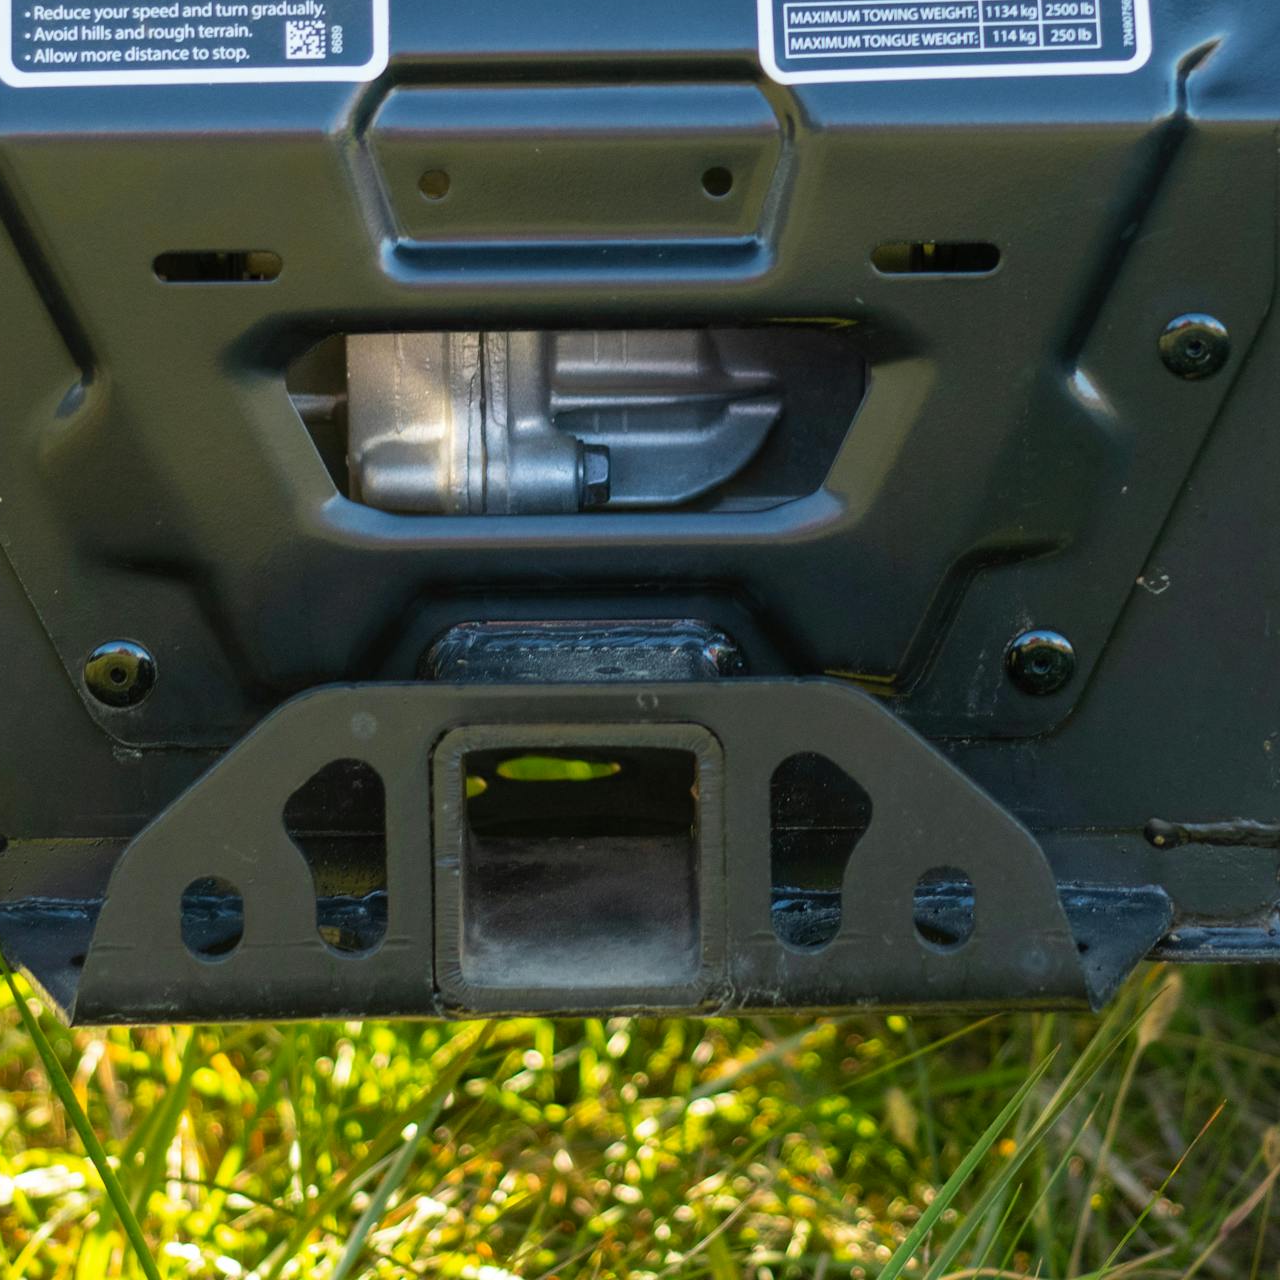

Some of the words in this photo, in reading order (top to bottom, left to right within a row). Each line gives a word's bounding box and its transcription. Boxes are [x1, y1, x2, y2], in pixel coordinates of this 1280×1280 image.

[33, 4, 91, 21] Reduce
[93, 7, 130, 23] your
[132, 2, 179, 22] speed
[182, 2, 212, 18] and
[215, 3, 248, 17] turn
[251, 0, 326, 20] gradually.
[790, 9, 861, 24] MAXIMUM
[861, 7, 919, 22] TOWING
[920, 6, 977, 20] WEIGHT:
[986, 5, 1018, 18] 1134
[1020, 3, 1038, 22] kg
[1045, 3, 1079, 17] 2500
[1080, 2, 1094, 15] lb
[33, 25, 78, 42] Avoid
[81, 25, 112, 40] hills
[114, 24, 146, 40] and
[146, 23, 195, 43] rough
[197, 23, 253, 39] terrain.
[790, 35, 861, 50] MAXIMUM
[862, 33, 920, 48] TONGUE
[921, 31, 979, 46] WEIGHT:
[993, 30, 1017, 42] 114
[1019, 28, 1037, 45] kg
[1051, 28, 1076, 42] 250
[1078, 28, 1092, 41] lb
[33, 48, 78, 63] Allow
[80, 50, 122, 63] more
[124, 46, 190, 62] distance
[191, 46, 210, 60] to
[212, 46, 250, 63] stop.
